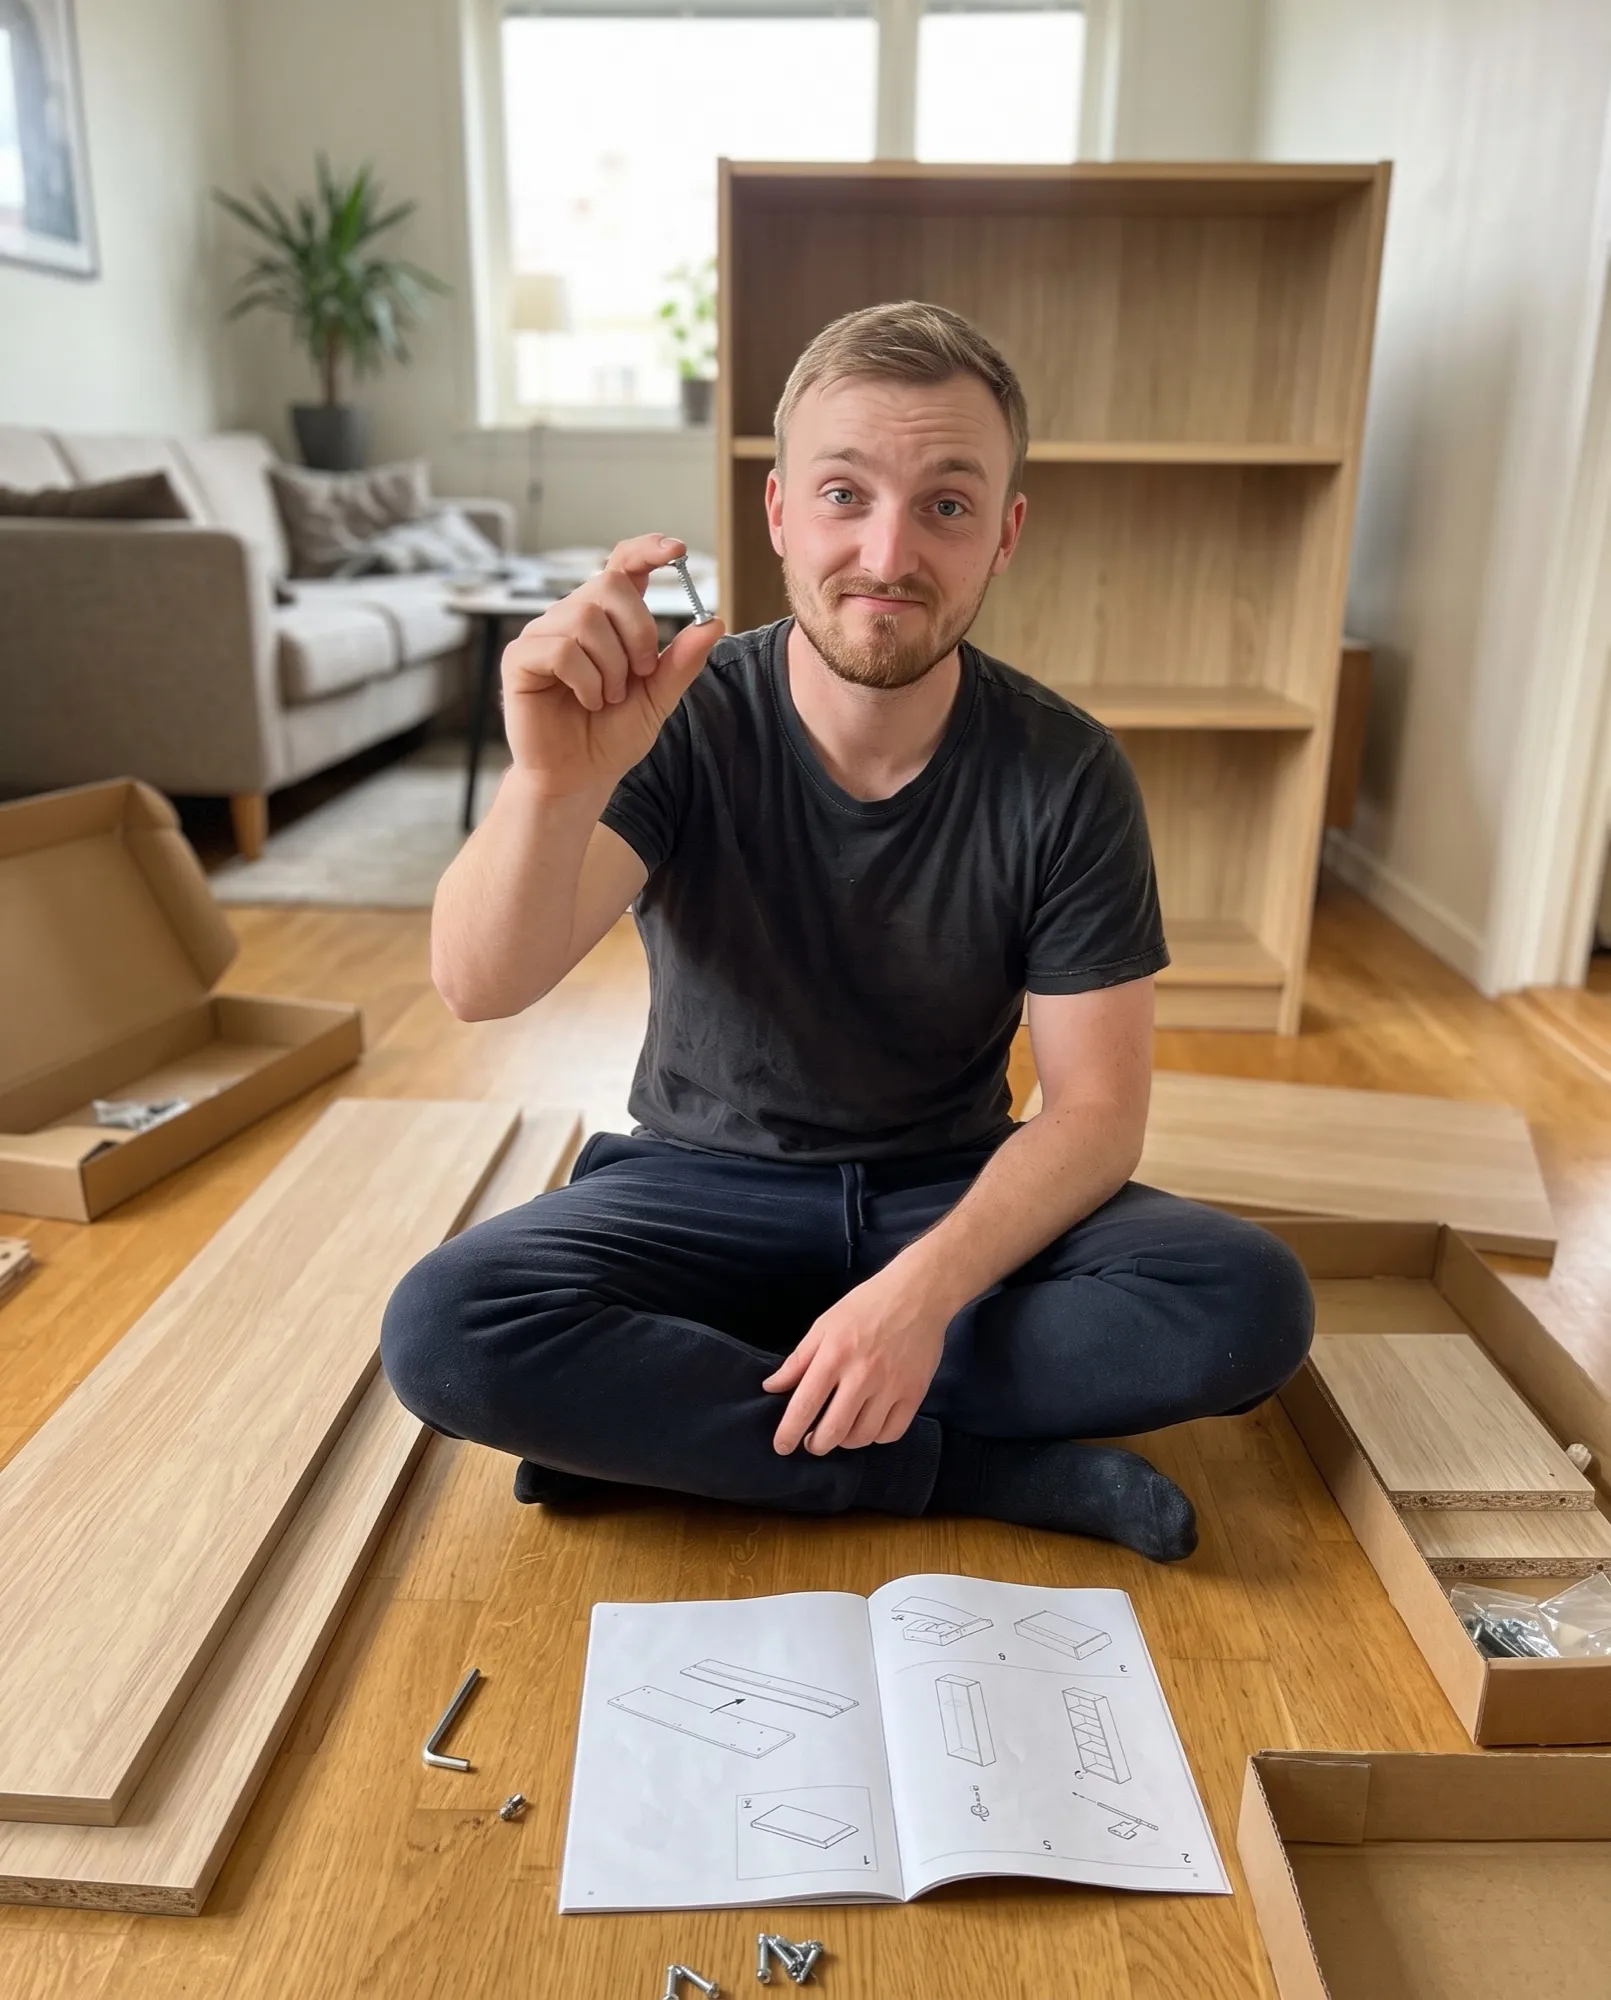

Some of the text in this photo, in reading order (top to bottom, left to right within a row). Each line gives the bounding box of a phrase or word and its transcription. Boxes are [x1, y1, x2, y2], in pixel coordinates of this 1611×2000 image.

[1118, 1664, 1128, 1672] 3
[1042, 1839, 1052, 1850] 5
[863, 1854, 870, 1865] 1
[1180, 1853, 1191, 1863] 2
